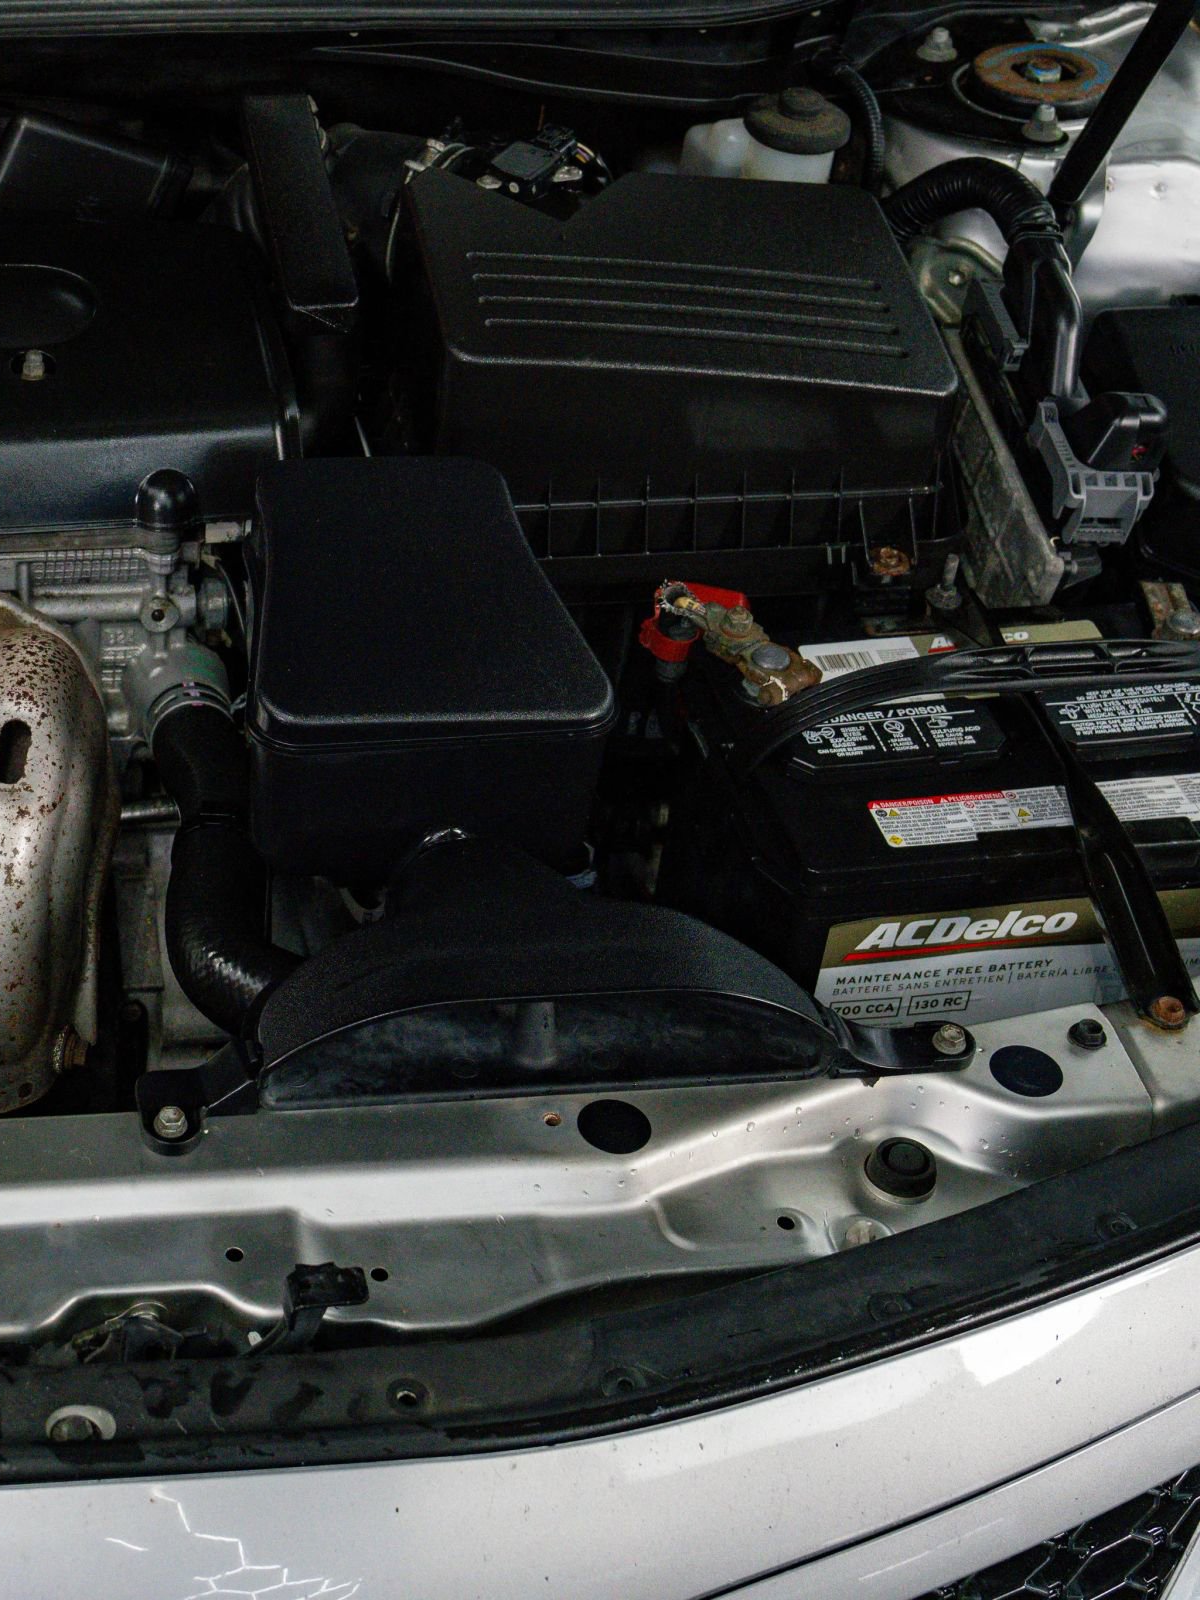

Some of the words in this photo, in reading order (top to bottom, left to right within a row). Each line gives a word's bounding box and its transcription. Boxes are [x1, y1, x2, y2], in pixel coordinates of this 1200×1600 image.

[896, 705, 947, 717] POISON
[879, 799, 935, 808] DANGER/POISON
[854, 910, 1079, 951] ACDelco
[836, 968, 942, 986] MAINTENANCE
[946, 965, 983, 978] FREE
[988, 959, 1054, 974] BATTERY
[832, 984, 893, 996] BATTERIE
[897, 981, 930, 992] SANS
[934, 975, 1005, 988] ENTRETIEN
[1016, 965, 1069, 981] BATERÍA
[1072, 964, 1109, 977] LIBRE
[834, 1005, 861, 1016] 700
[865, 1002, 894, 1014] CCA
[914, 999, 939, 1010] 130
[942, 996, 963, 1008] RC
